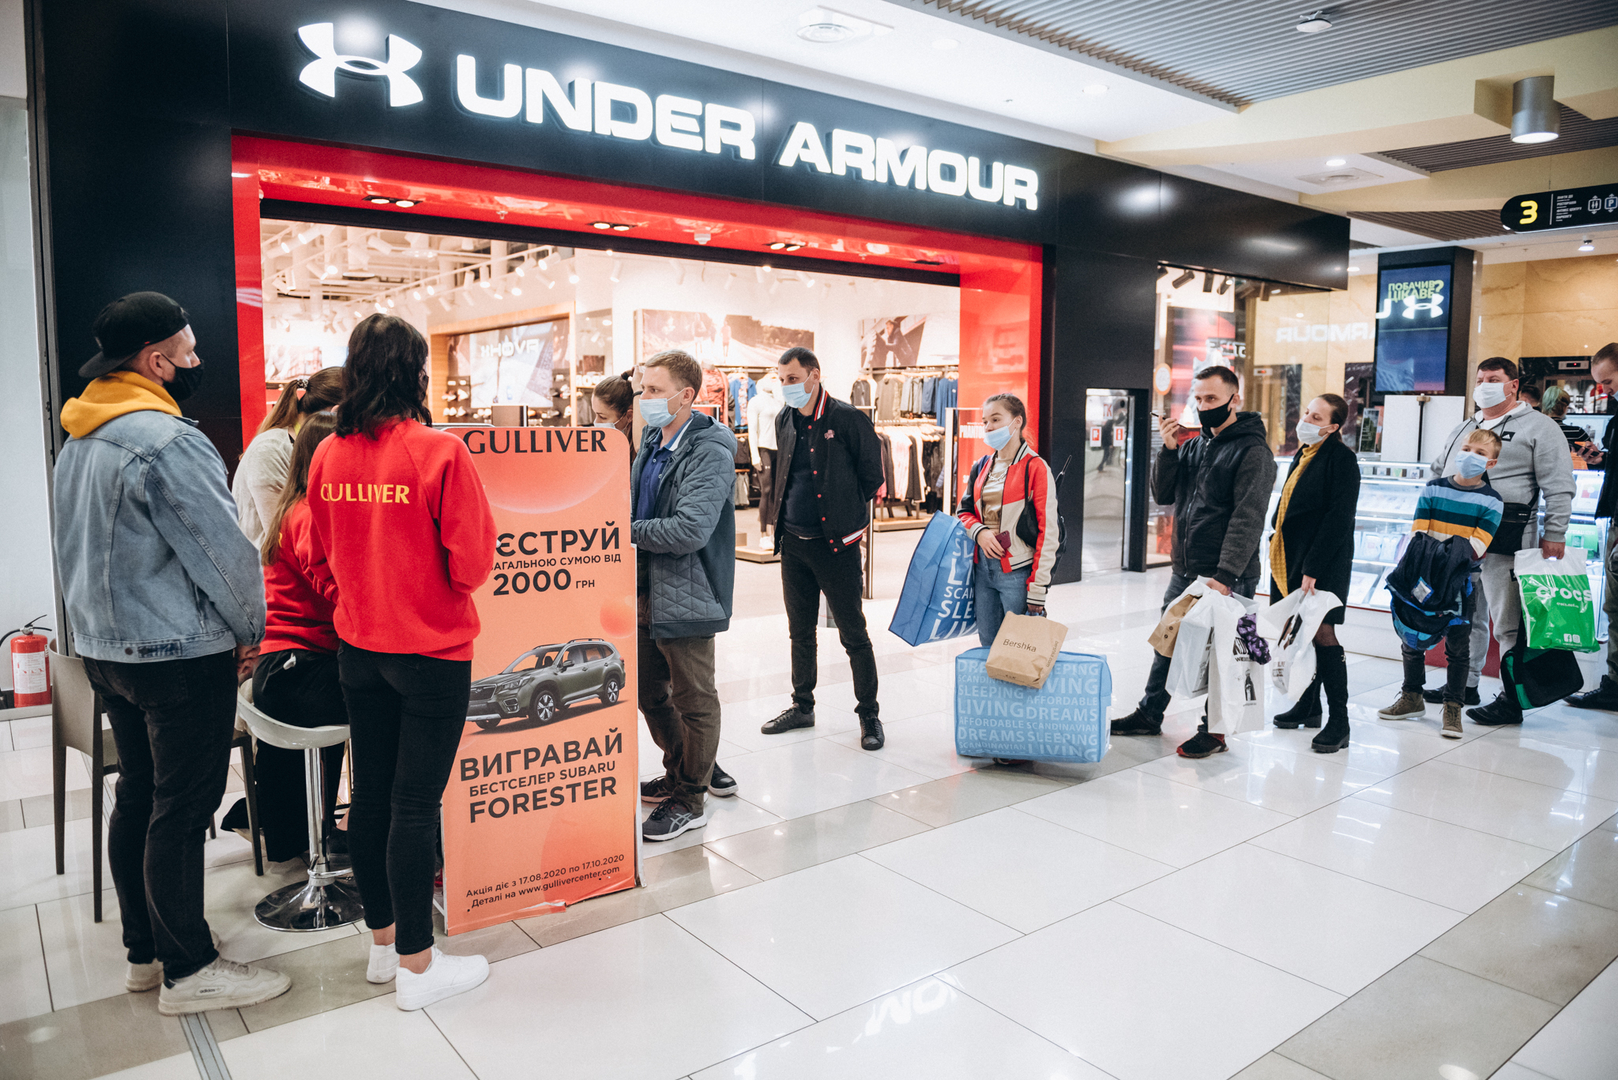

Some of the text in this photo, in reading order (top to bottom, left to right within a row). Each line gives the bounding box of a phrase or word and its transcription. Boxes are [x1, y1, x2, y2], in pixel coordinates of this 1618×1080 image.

[456, 54, 1039, 211] UNDER ARMOUR
[1519, 200, 1538, 225] 3
[1388, 280, 1435, 292] ПОБАЧИВ
[463, 430, 607, 454] GULLIVER
[320, 483, 410, 504] GULLIVER
[496, 521, 620, 557] ЄСТРУЙ
[492, 553, 621, 571] АГАЛЬНОЮ СУМОЮ ВІД
[493, 568, 595, 596] 2000 ГРН
[943, 586, 974, 599] SCAN
[1536, 586, 1593, 602] crocs
[938, 600, 974, 619] SLE
[1003, 638, 1037, 653] Bershka
[958, 659, 987, 674] DRE
[1054, 663, 1099, 676] EPING
[958, 684, 1024, 699] SLEEPING
[1046, 677, 1099, 695] VING
[958, 698, 1025, 718] LIVING
[1026, 694, 1098, 706] AFFORDABLE
[959, 716, 1025, 729] AFFORDABLE
[1025, 706, 1098, 722] DREAMS
[958, 726, 1025, 742] DREAMS
[1026, 721, 1098, 732] SCANDINAVIAN
[959, 741, 1026, 751] SCANDINAVIAN
[1027, 731, 1098, 746] SLEEPING
[460, 727, 623, 781] ВИГРАВАЙ
[469, 760, 616, 797] БЕСТСЕЛЕР SUBARU
[470, 776, 617, 823] FORESTER
[466, 885, 493, 898] Акція
[495, 881, 510, 892] діє
[519, 867, 567, 884] 17.08.2020
[569, 865, 580, 873] по
[582, 853, 625, 870] 17.10.2020
[471, 865, 620, 909] Деталі на www.gullivercenter.com
